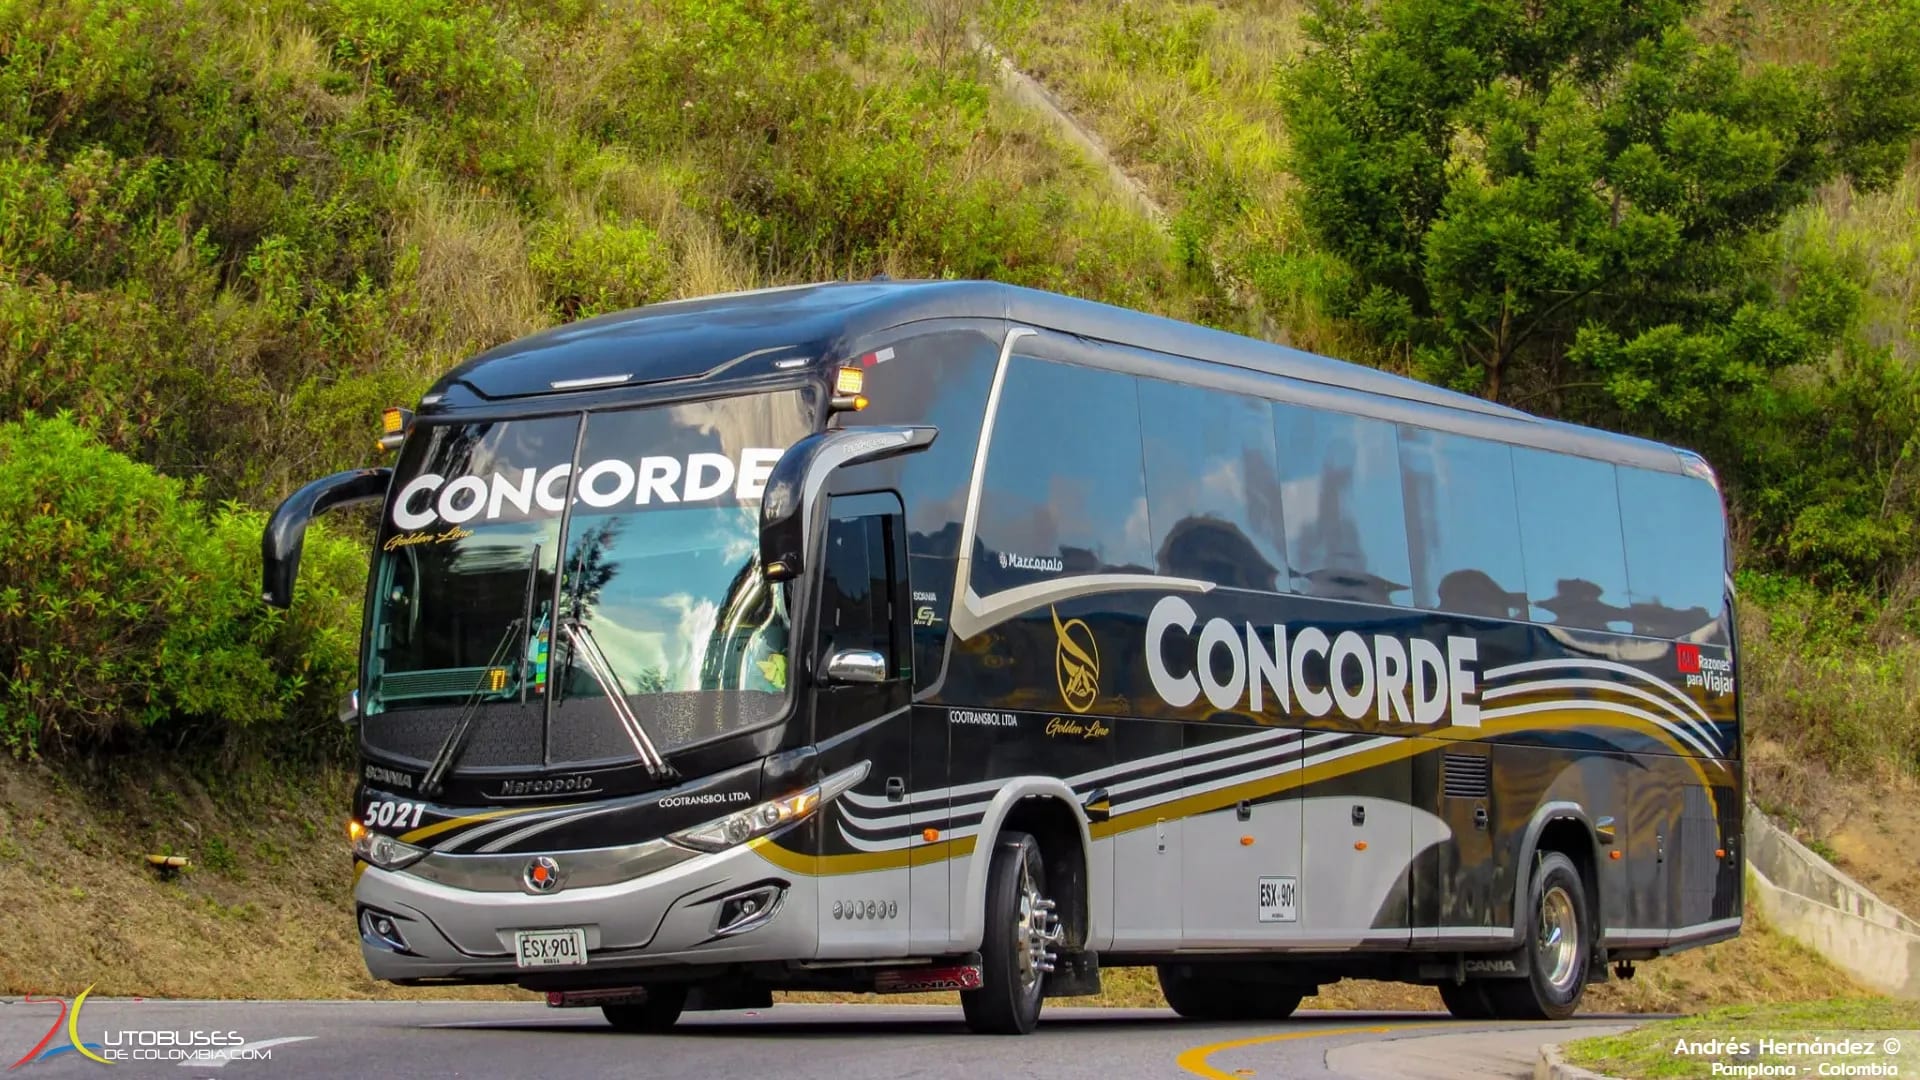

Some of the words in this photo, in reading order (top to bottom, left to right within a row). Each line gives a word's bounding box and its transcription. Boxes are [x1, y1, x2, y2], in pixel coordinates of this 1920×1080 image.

[393, 448, 785, 530] CONCORDE
[384, 531, 434, 551] Golden
[435, 526, 474, 544] Line
[1009, 553, 1063, 572] Marcopolo
[913, 591, 937, 602] SCANIA
[1145, 595, 1480, 728] CONCORDE
[1698, 655, 1730, 671] Razones
[1687, 674, 1703, 688] para
[1703, 670, 1733, 697] Viajar
[950, 711, 1000, 726] COOTRANSBOL
[1001, 714, 1018, 727] LTDA
[1046, 717, 1083, 737] Golden
[1084, 719, 1110, 739] Line
[365, 765, 413, 789] SCANIA
[501, 777, 594, 795] Marcopolo
[659, 793, 727, 808] COOTRANSBOL
[728, 791, 752, 802] LTDA
[364, 801, 426, 828] 5021
[1465, 959, 1517, 972] CANIA
